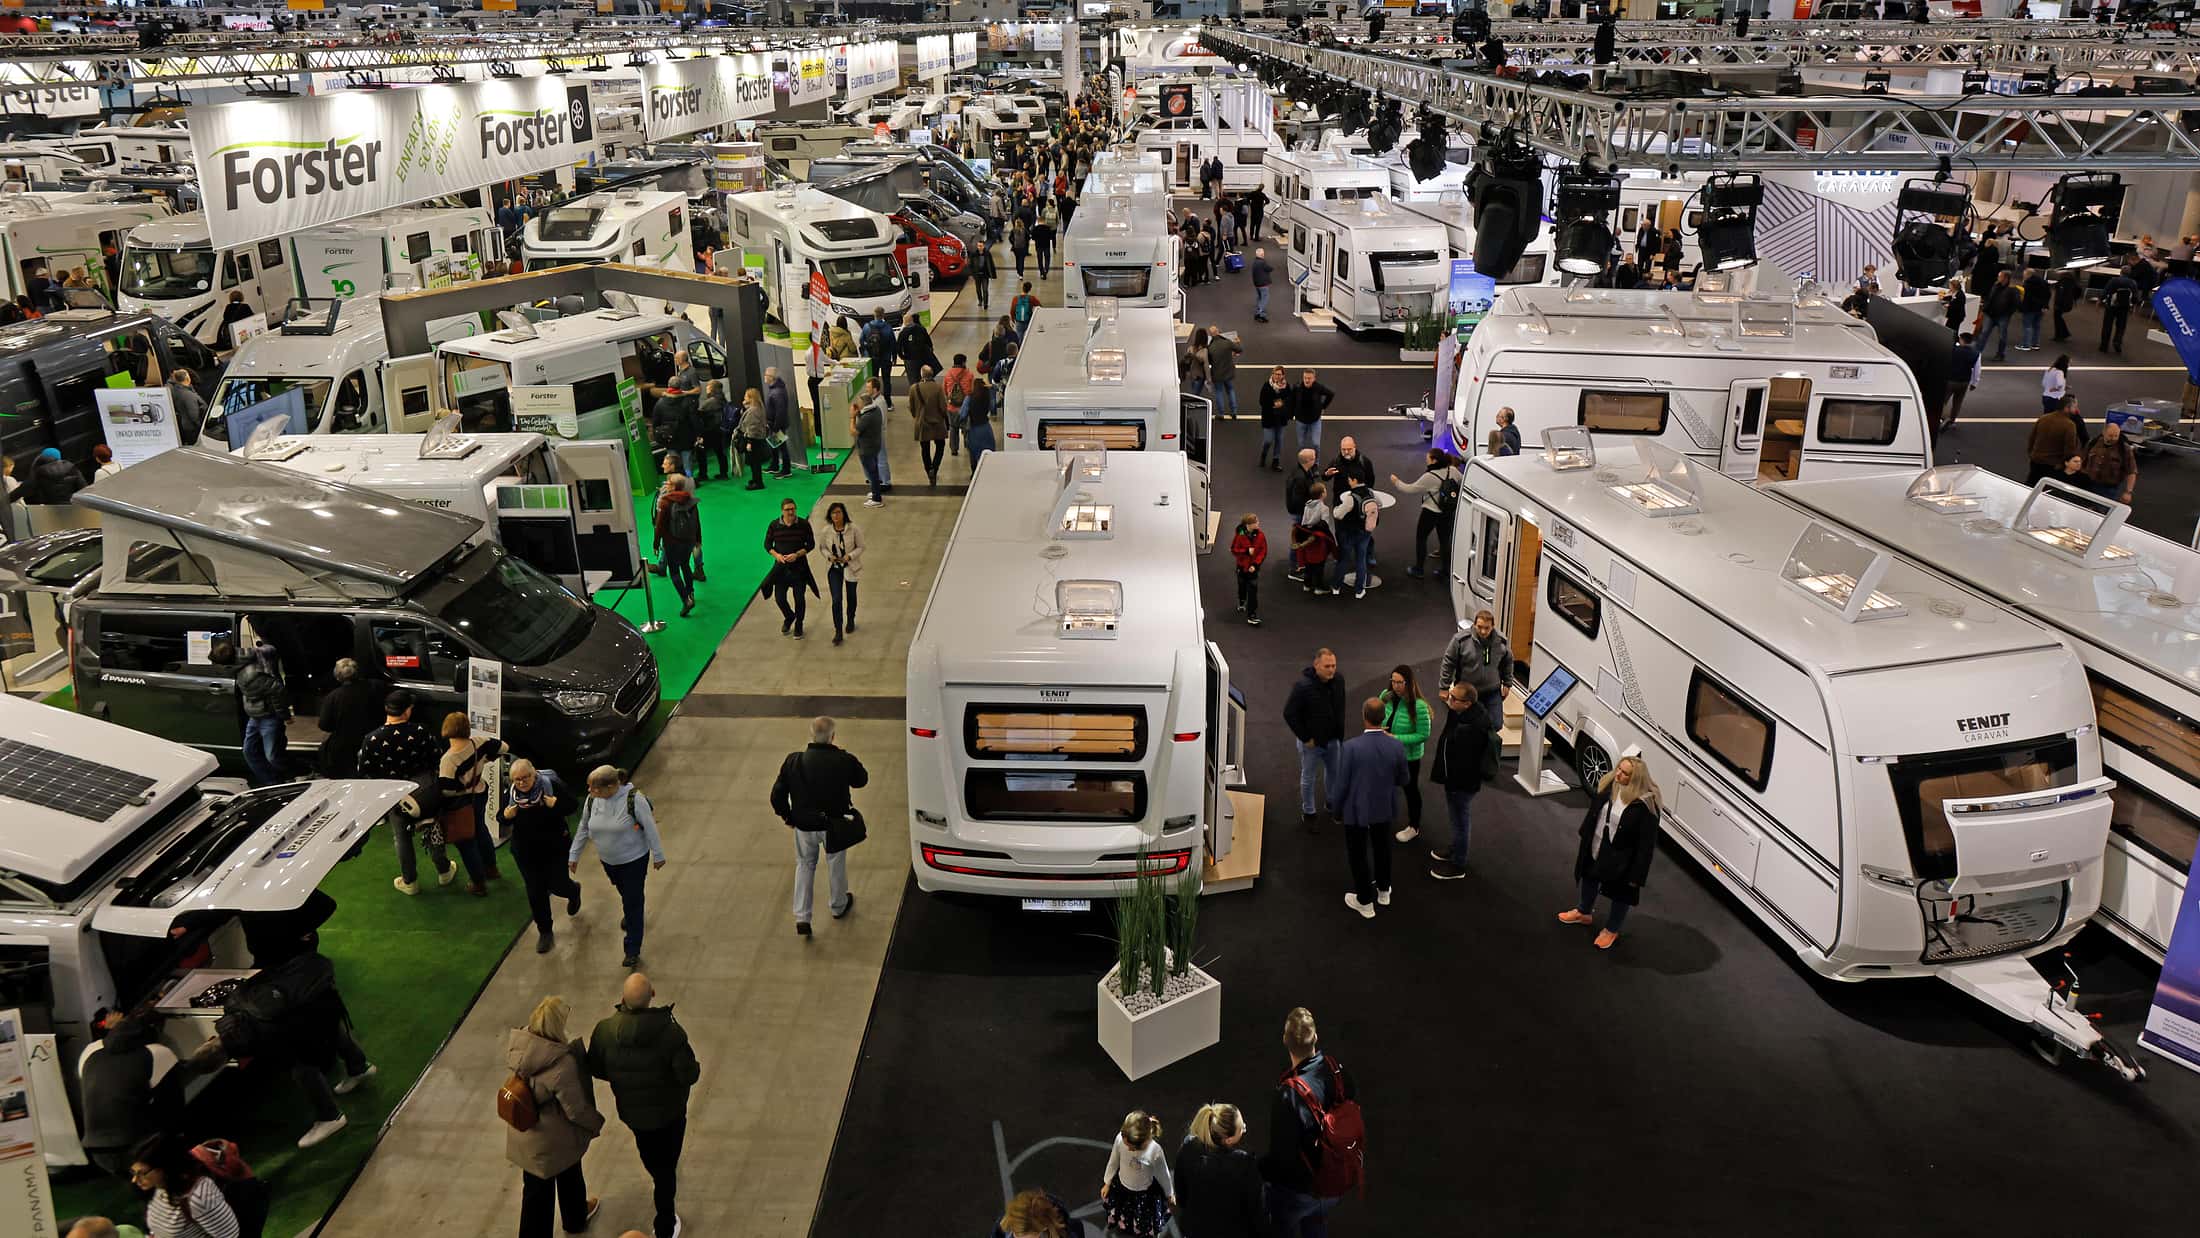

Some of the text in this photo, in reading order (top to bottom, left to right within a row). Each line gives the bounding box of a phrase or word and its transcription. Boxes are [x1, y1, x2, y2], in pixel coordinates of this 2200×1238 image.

[736, 76, 771, 103] Forster
[652, 83, 701, 121] Forster
[481, 107, 568, 160] Forster
[1888, 133, 1908, 144] FENDT
[223, 137, 382, 211] Forster
[1817, 181, 1893, 193] CARAVAN
[324, 247, 354, 255] Forster
[530, 392, 558, 400] Forster
[415, 498, 452, 508] orster
[109, 675, 146, 685] PANAMA
[1957, 713, 2011, 732] FENDT
[1964, 729, 2009, 743] CARAVAN
[286, 812, 336, 852] PANAMA
[24, 1164, 44, 1233] PANAMA
